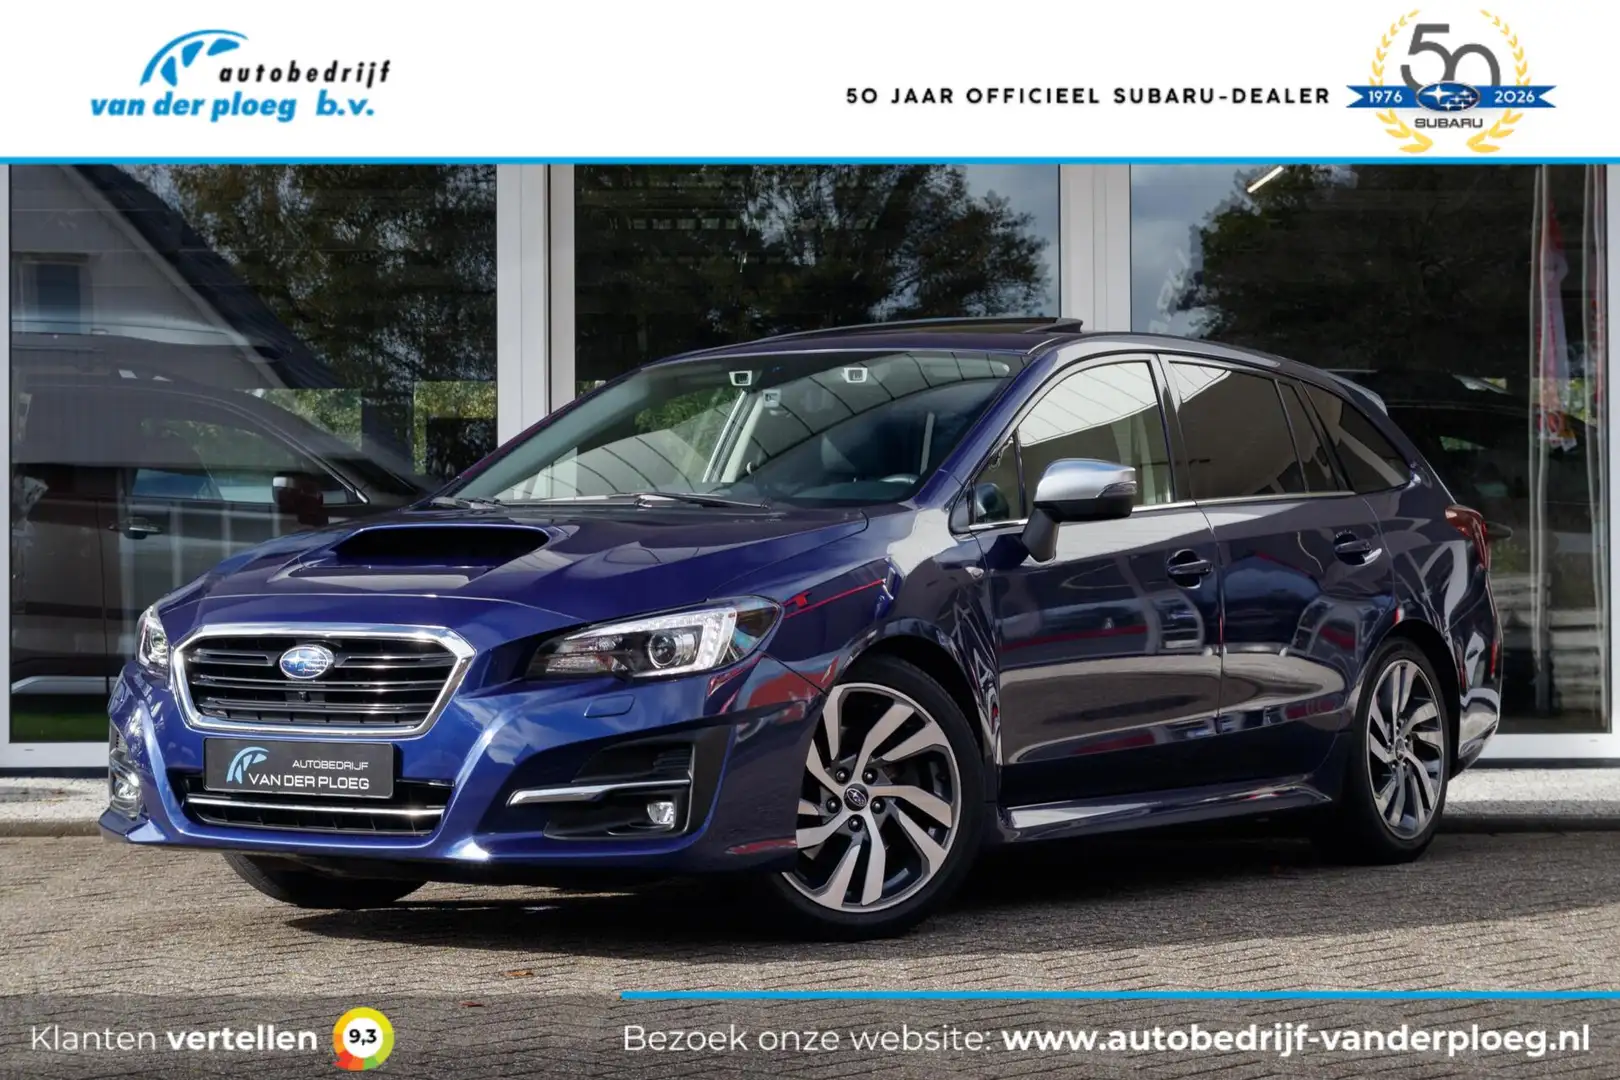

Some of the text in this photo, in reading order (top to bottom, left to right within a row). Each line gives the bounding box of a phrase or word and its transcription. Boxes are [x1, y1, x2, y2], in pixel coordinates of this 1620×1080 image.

[292, 759, 369, 771] AUTOBEDRIJF
[248, 772, 370, 790] VAN DER PLOEG
